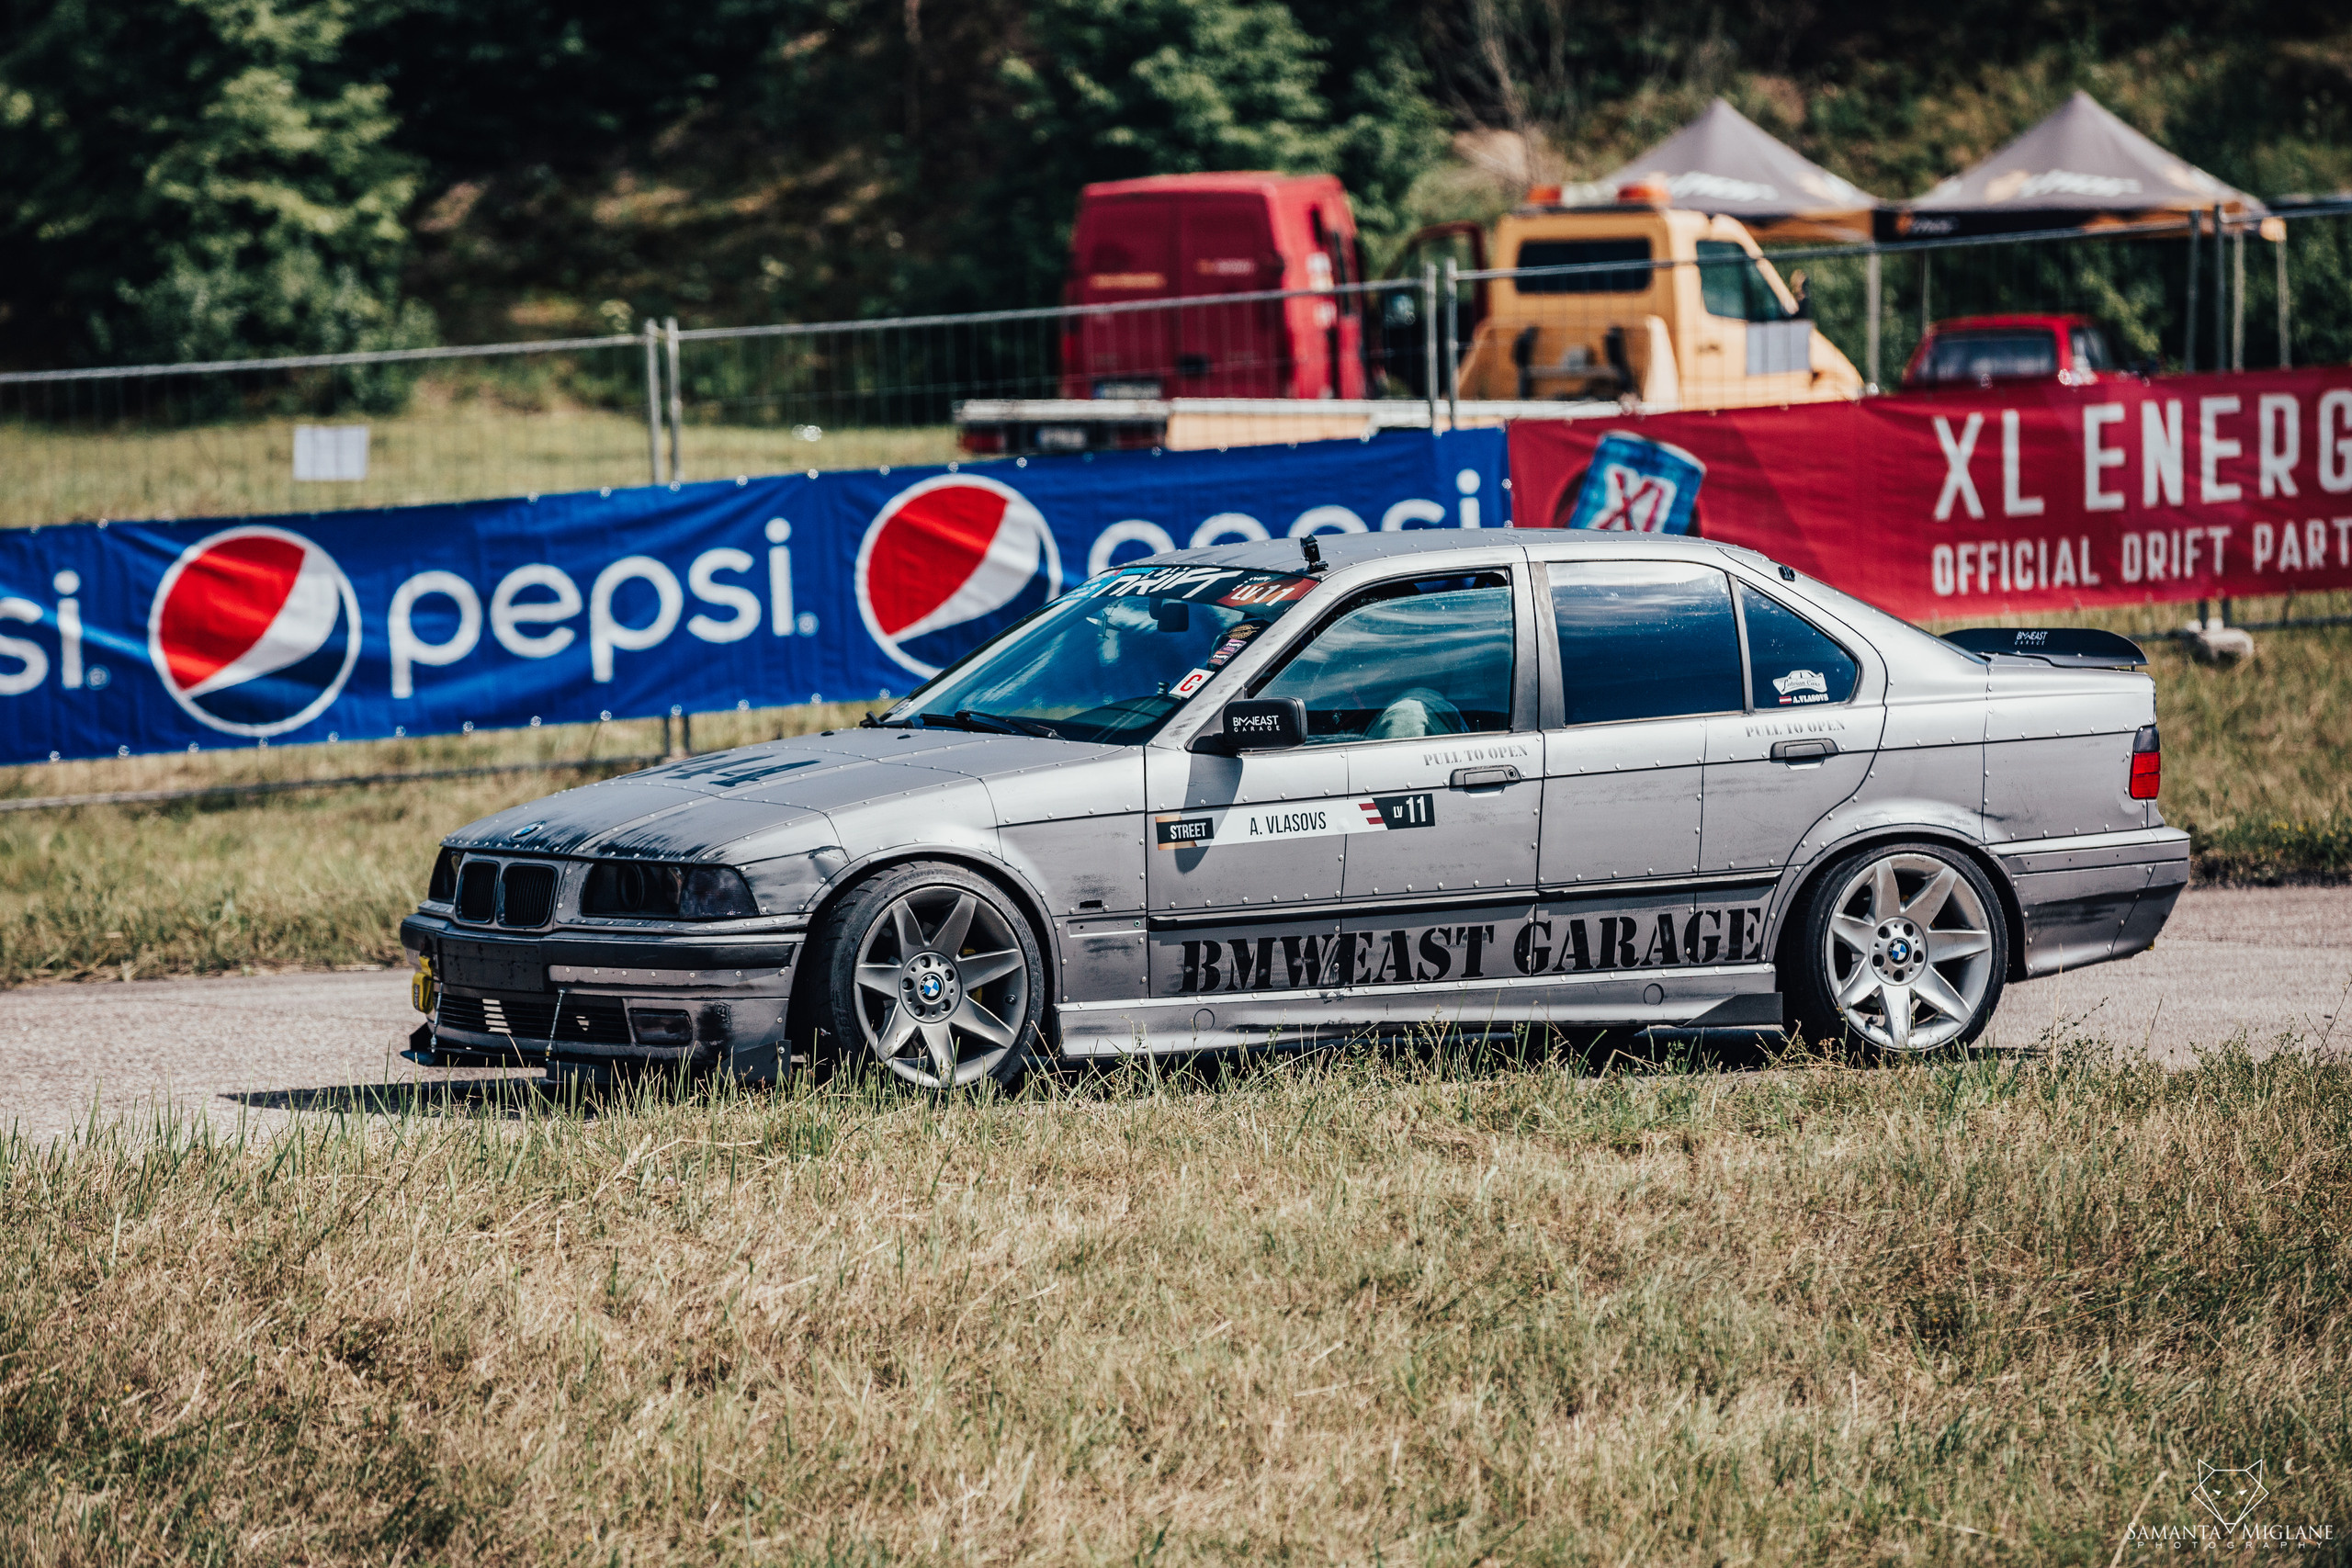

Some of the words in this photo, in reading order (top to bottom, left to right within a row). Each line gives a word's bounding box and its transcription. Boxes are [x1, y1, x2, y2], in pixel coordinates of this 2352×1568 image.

[1932, 409, 2045, 522] XL
[2082, 388, 2352, 513] ENERG
[1932, 536, 2101, 596] OFFICIAL
[2120, 525, 2233, 583] DRIFT
[2252, 515, 2352, 573] PART
[389, 517, 794, 699] pepsi
[1180, 673, 1203, 692] C
[1232, 715, 1280, 727] BMWEAST
[1233, 725, 1281, 733] GARAGE
[1745, 724, 1782, 738] PULL
[1783, 722, 1803, 735] TO
[1807, 719, 1846, 732] OPEN
[1422, 750, 1463, 766] PULL
[1464, 749, 1484, 761] TO
[1488, 744, 1528, 759] OPEN
[1170, 821, 1206, 840] STREET
[1250, 817, 1262, 836] A.
[1265, 811, 1327, 833] VLASOVS
[1392, 805, 1404, 818] LV
[1406, 795, 1427, 823] 11
[1179, 924, 1495, 993] BMWEAST
[1513, 907, 1761, 976] GARAGE
